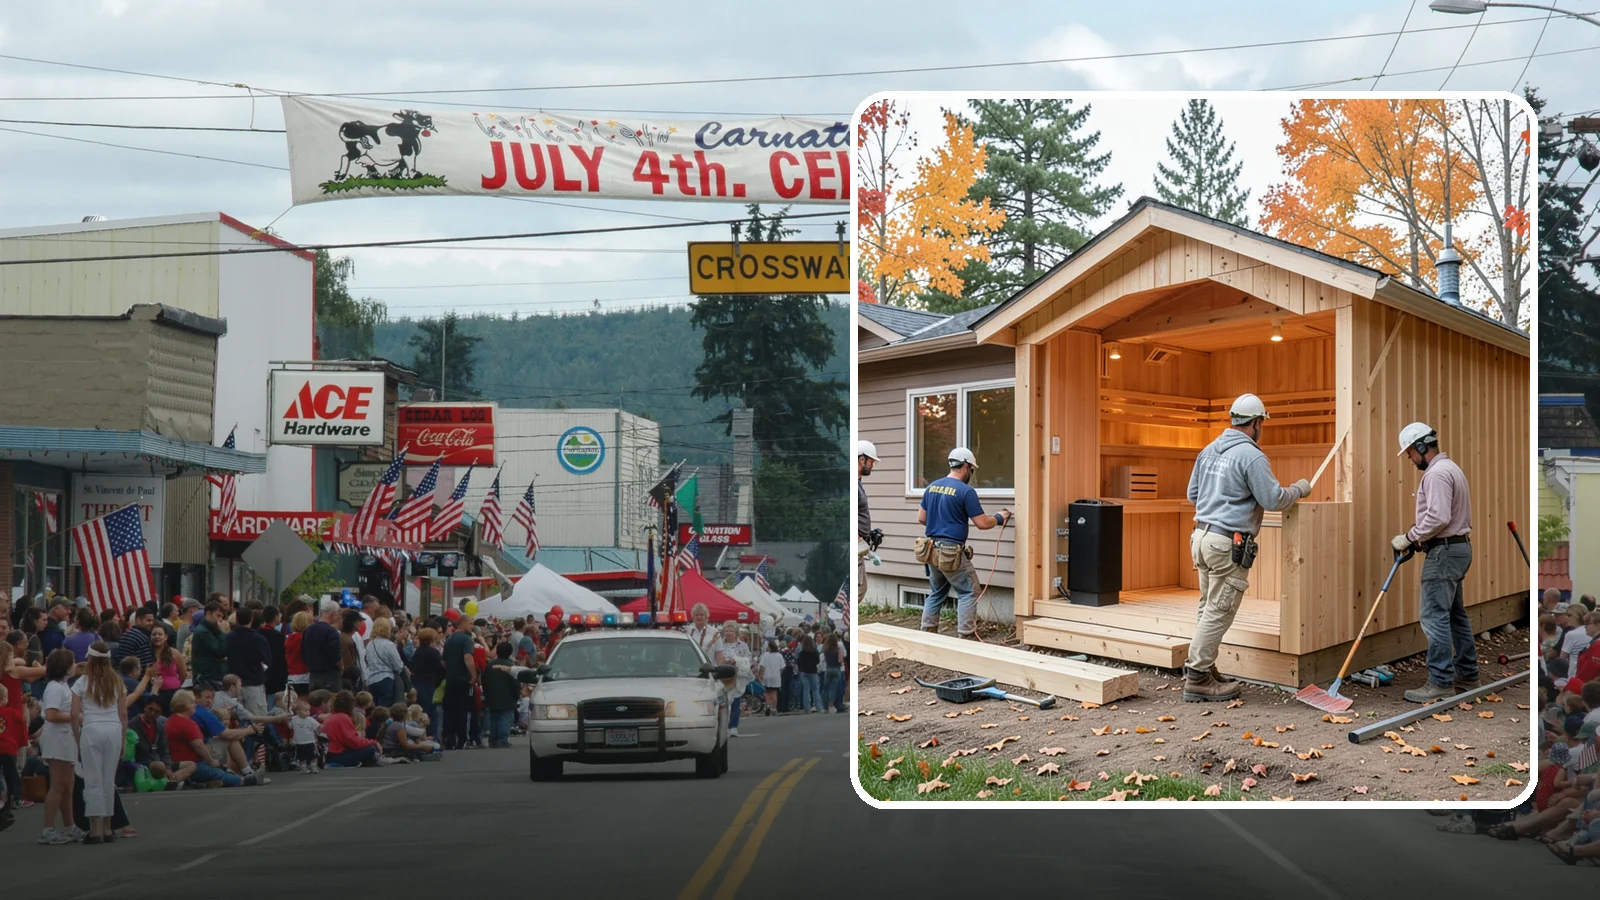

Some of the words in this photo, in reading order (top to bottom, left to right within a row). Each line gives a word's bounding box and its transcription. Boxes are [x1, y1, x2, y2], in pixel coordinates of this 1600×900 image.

[481, 141, 604, 192] JULY
[632, 150, 746, 198] 4th.
[696, 254, 850, 280] CROSSWA
[283, 380, 374, 420] ACE
[406, 409, 452, 422] CEDAR
[461, 409, 485, 422] LOG
[283, 421, 371, 437] Hardware
[416, 428, 477, 447] Coca-Cola
[95, 485, 124, 495] Vincent
[126, 486, 135, 495] de
[137, 486, 155, 495] Paul
[688, 526, 741, 535] CRNATION
[699, 535, 730, 543] GLASS
